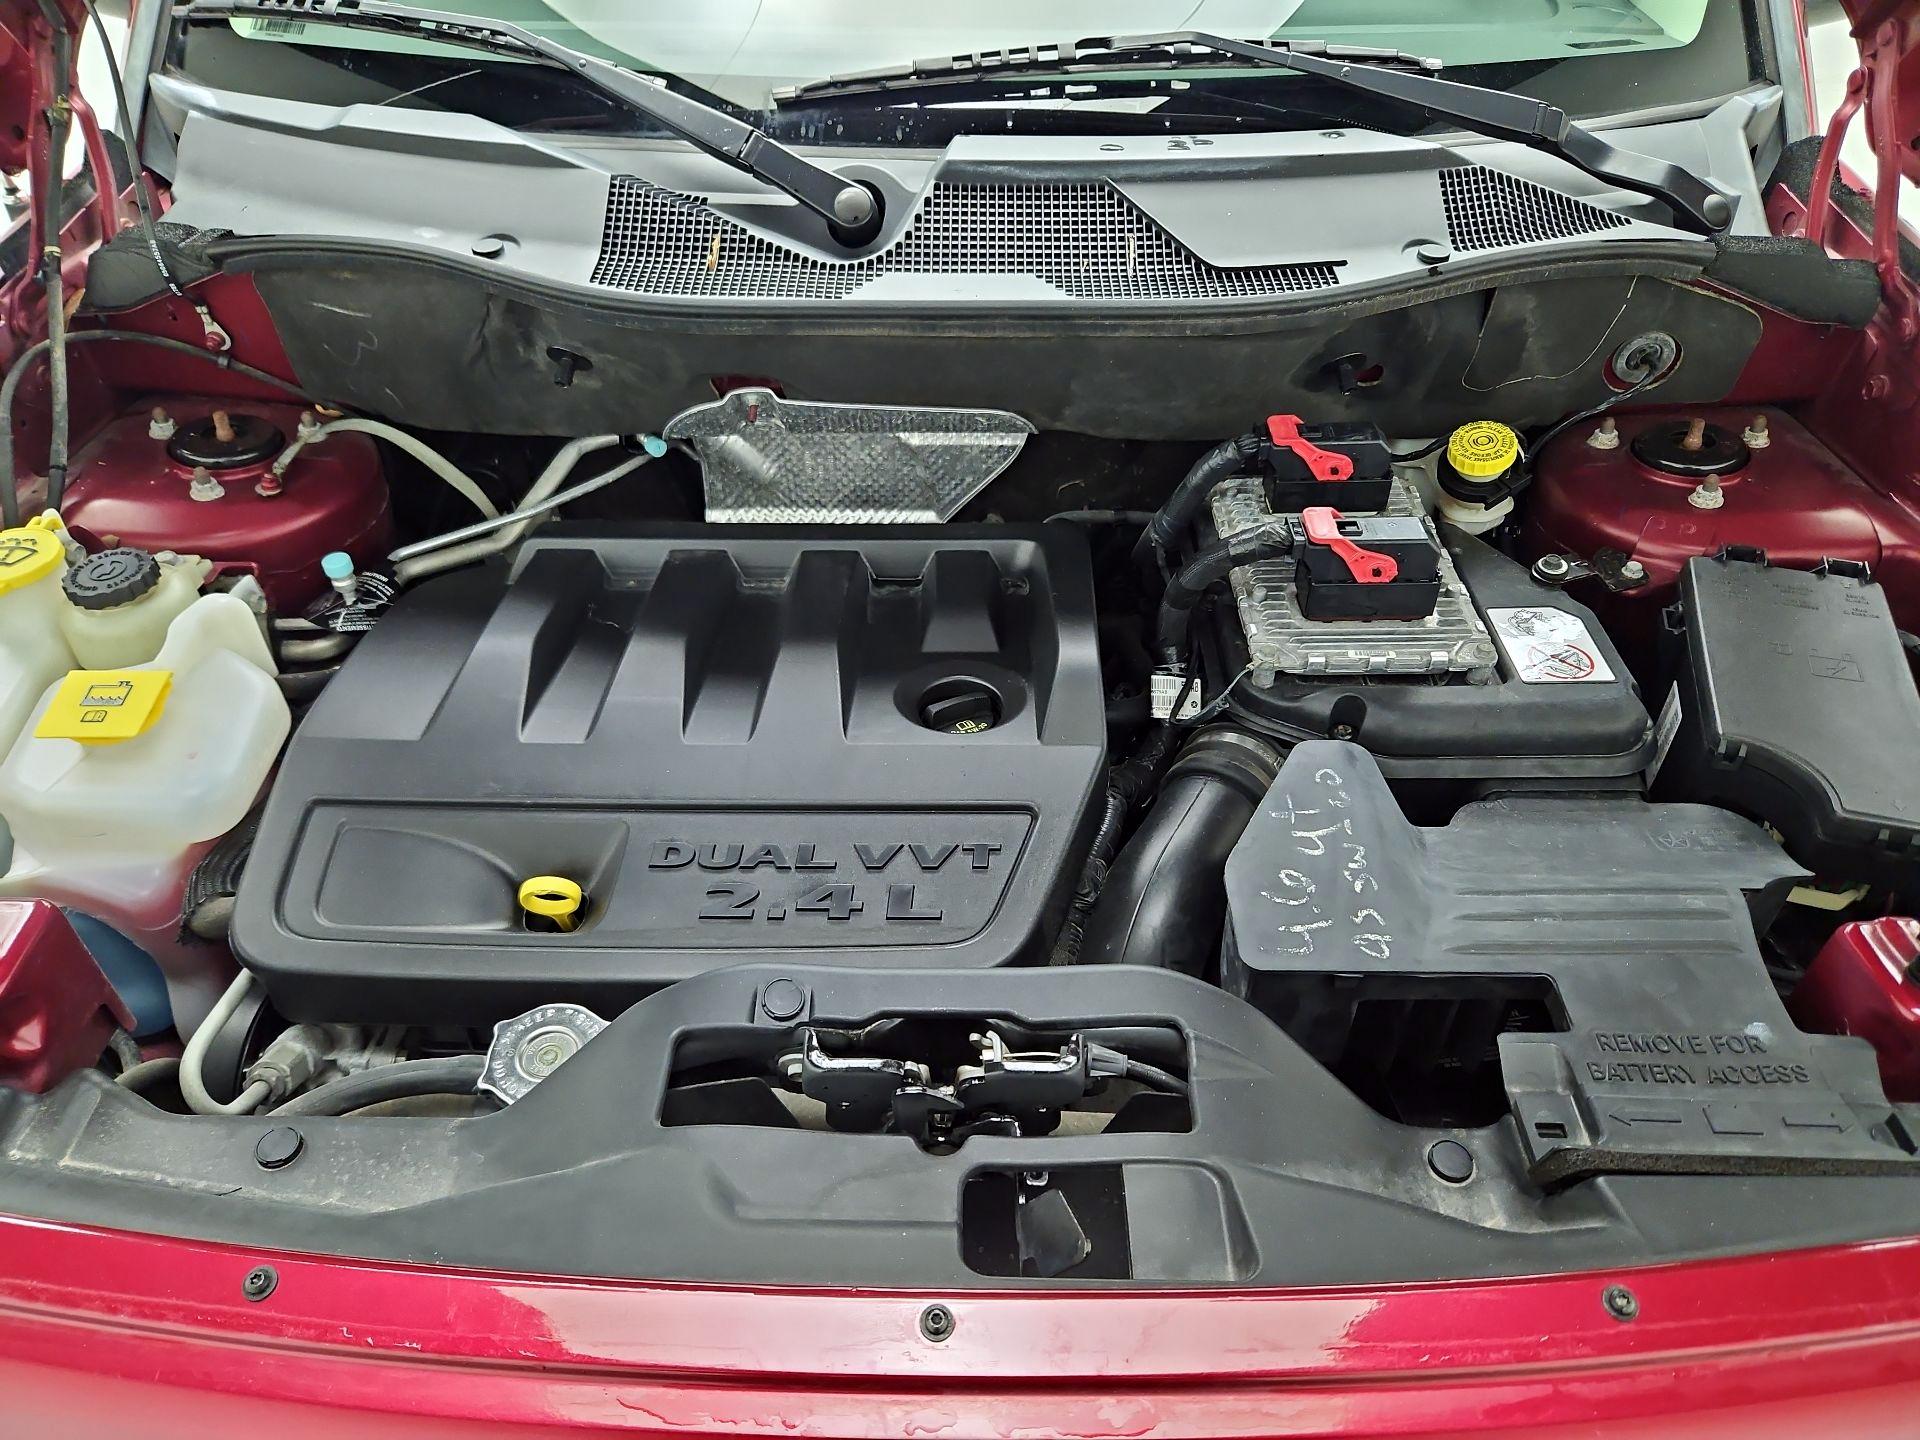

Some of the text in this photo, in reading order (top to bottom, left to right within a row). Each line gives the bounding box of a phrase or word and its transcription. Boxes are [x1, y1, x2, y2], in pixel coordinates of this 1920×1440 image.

[648, 841, 1002, 871] DUAL VVT
[1594, 1031, 1768, 1055] REMOVE FOR
[1586, 1061, 1812, 1084] BATTERY ACCESS
